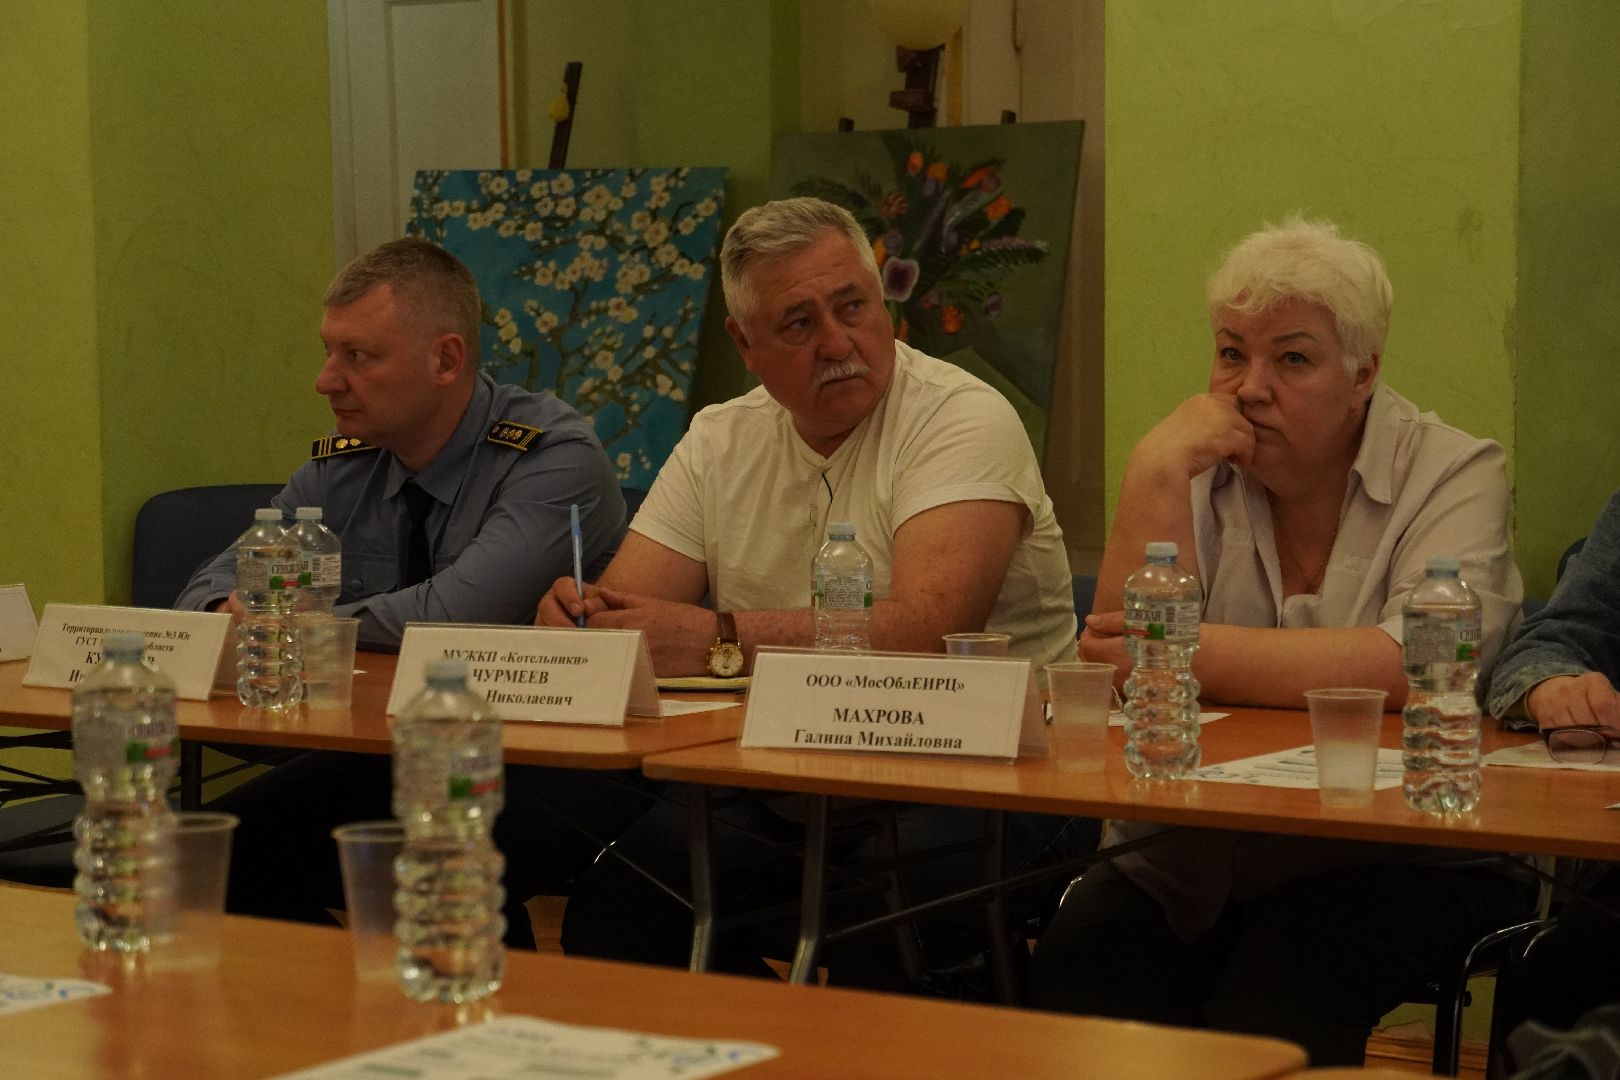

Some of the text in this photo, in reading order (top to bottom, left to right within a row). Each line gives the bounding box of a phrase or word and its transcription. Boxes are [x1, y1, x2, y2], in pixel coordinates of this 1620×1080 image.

[500, 651, 589, 666] «Котельники»
[472, 668, 550, 685] ЧУРМЕЕВ
[805, 674, 965, 694] ООО «МосОблЕИРЦ»
[486, 689, 573, 706] Николаевич
[832, 708, 925, 726] МАХРОВА
[794, 729, 963, 750] Галина Михайловна
